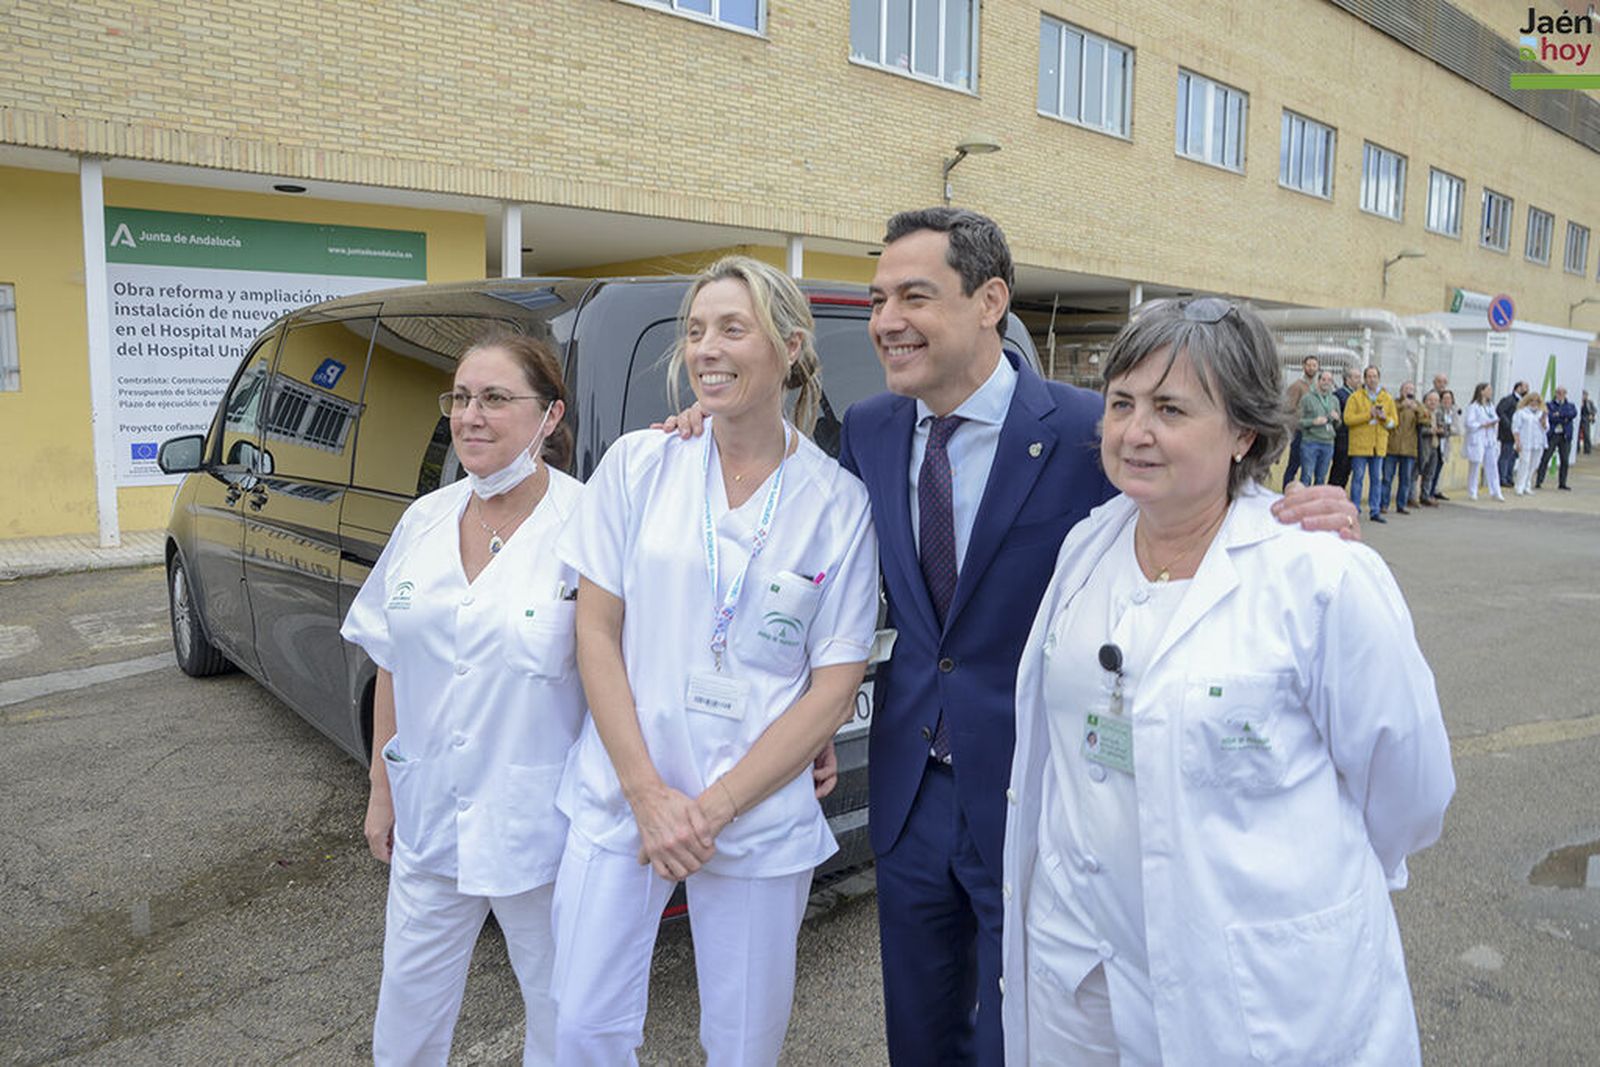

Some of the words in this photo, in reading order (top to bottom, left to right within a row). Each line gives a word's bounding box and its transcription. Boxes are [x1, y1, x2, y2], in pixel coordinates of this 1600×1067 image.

[139, 231, 171, 243] Junta
[173, 233, 188, 244] de
[189, 234, 242, 248] Andalucía
[113, 281, 155, 297] Obra
[159, 284, 223, 300] reforma
[227, 290, 236, 304] y
[240, 288, 321, 304] ampliación
[114, 301, 205, 318] instalación
[209, 305, 228, 319] de
[232, 310, 279, 320] nuevo
[115, 325, 136, 337] en
[141, 323, 156, 337] el
[160, 324, 226, 340] Hospital
[116, 342, 143, 357] del
[147, 343, 215, 360] Hospital
[219, 344, 248, 358] Uni
[118, 388, 173, 398] Presupuesto
[175, 388, 185, 397] de
[119, 400, 144, 409] Plazo
[145, 400, 156, 409] de
[119, 423, 163, 434] Proyecto
